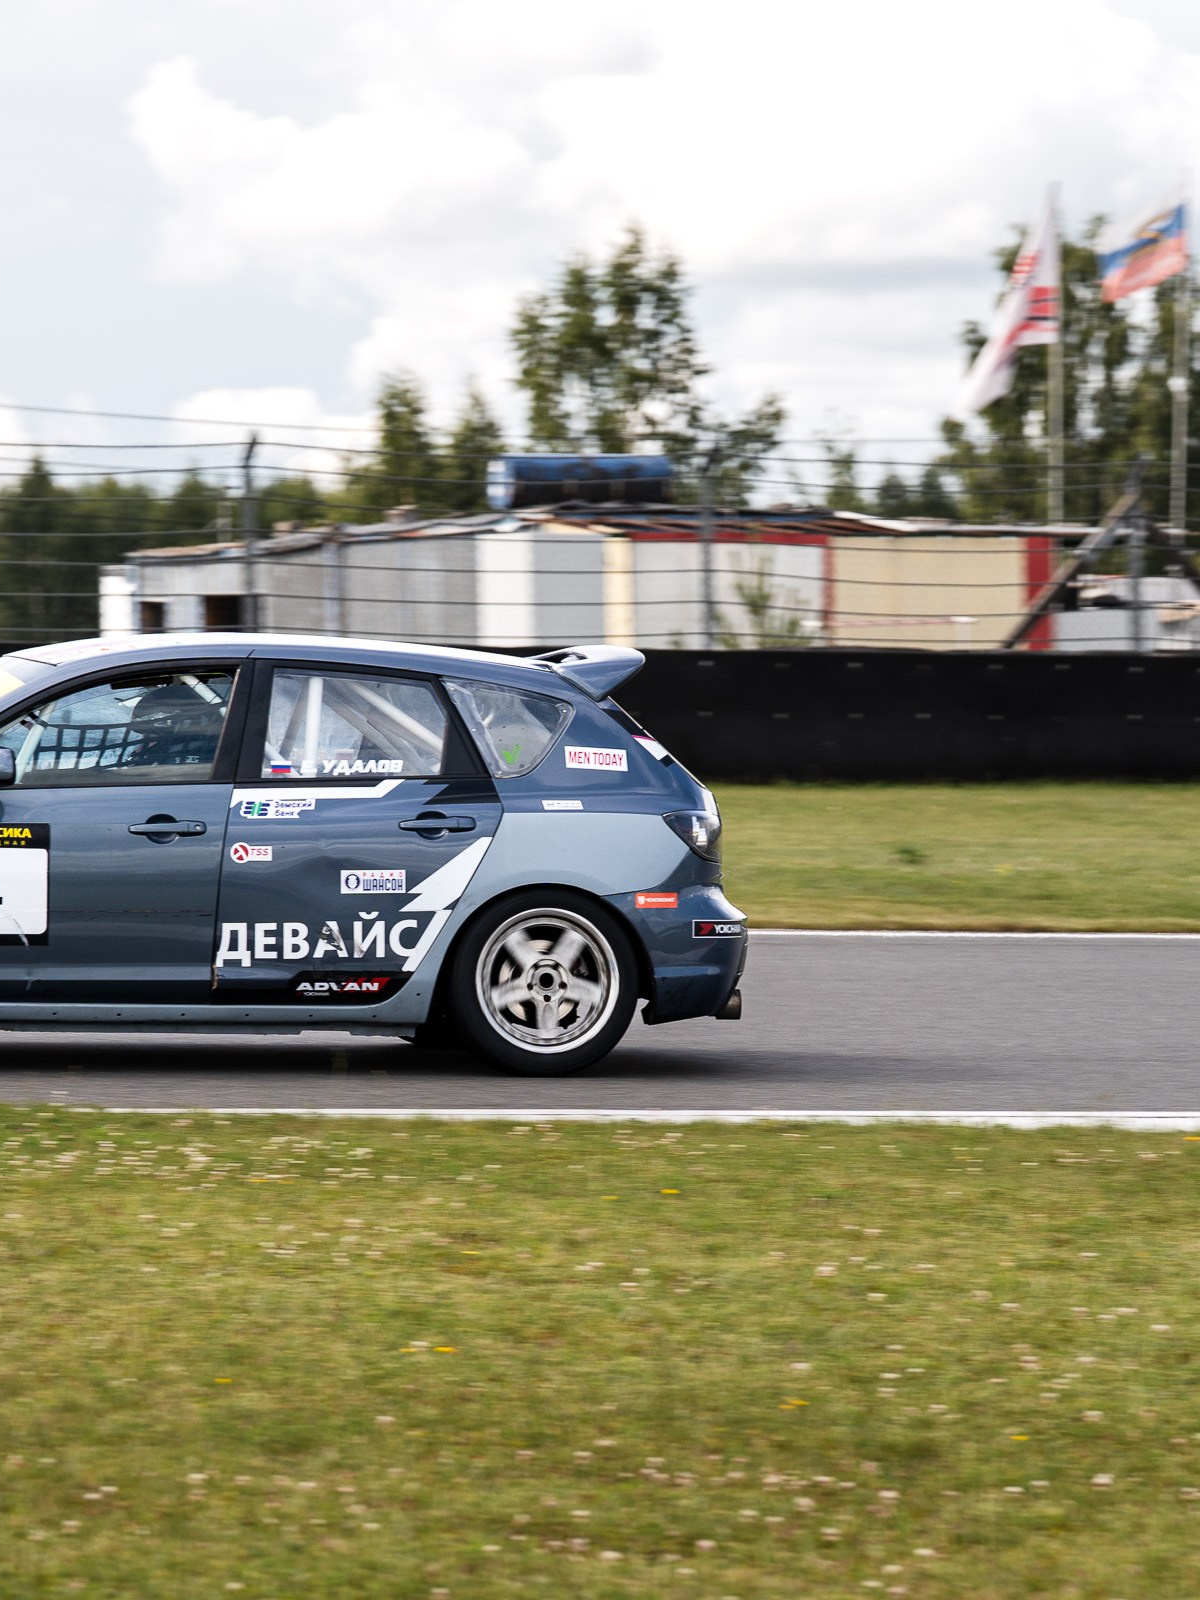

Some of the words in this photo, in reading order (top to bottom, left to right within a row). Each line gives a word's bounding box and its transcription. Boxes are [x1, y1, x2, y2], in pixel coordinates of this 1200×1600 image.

[568, 751, 590, 764] MEN
[592, 752, 624, 767] TODAY
[321, 760, 404, 776] УДАЛОВ
[250, 848, 269, 856] TSS
[362, 878, 404, 891] ШАНСОН
[216, 911, 424, 971] ДЕВАЙС
[295, 982, 380, 991] ADVAN
